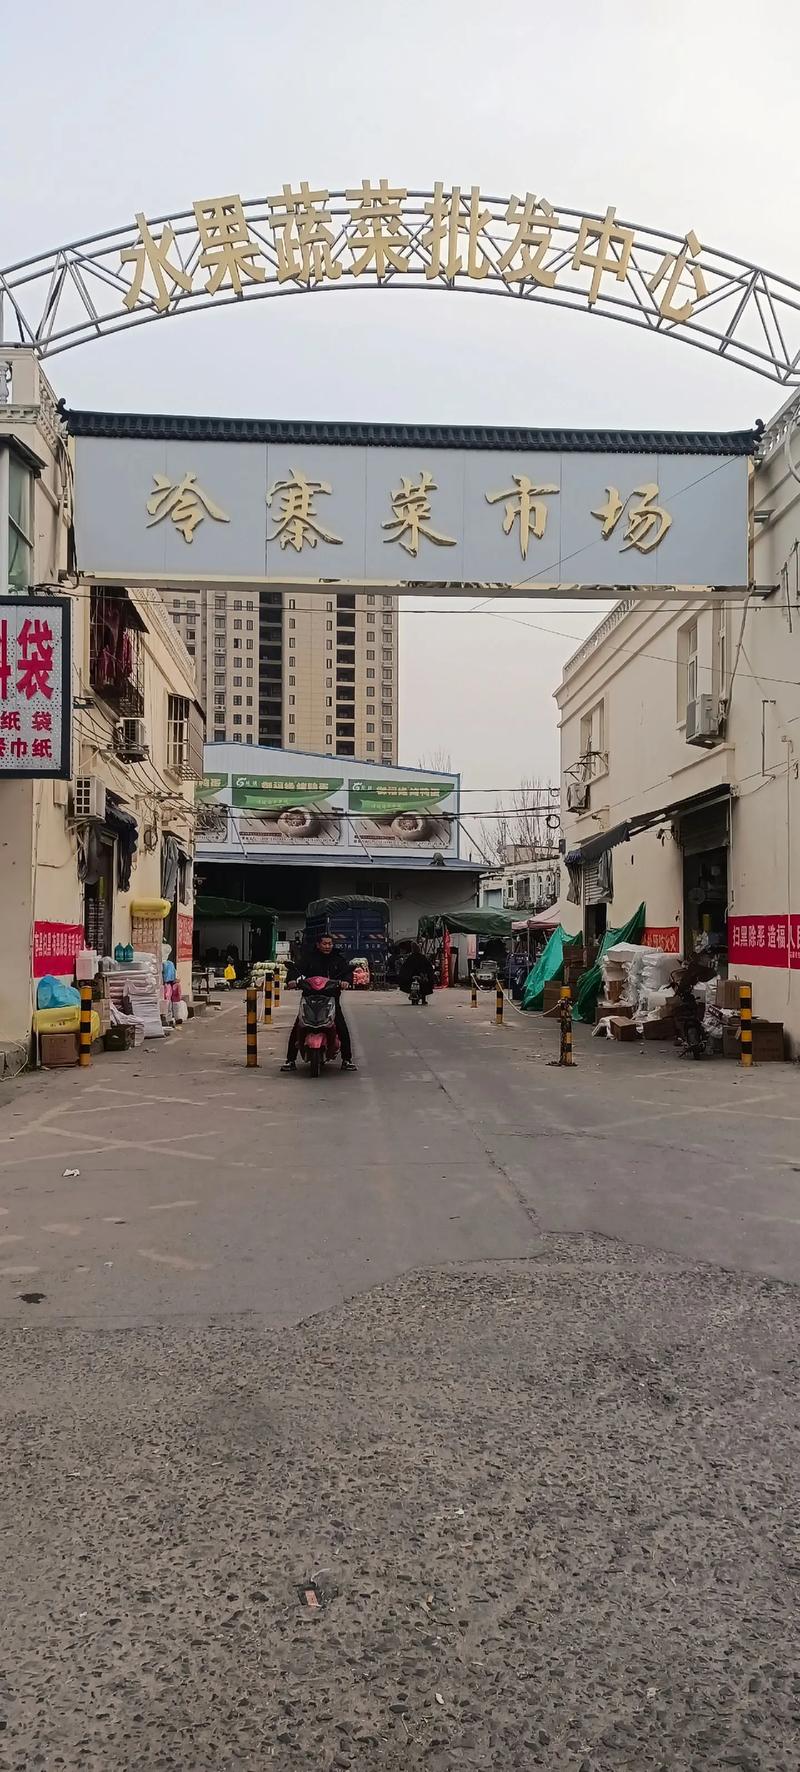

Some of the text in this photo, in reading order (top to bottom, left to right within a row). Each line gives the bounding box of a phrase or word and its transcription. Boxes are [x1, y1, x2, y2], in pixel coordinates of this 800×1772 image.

[120, 179, 709, 321] 水果蔬菜批发中心
[145, 468, 673, 561] 冷寨菜市场
[733, 924, 765, 948] 扫黑除恶
